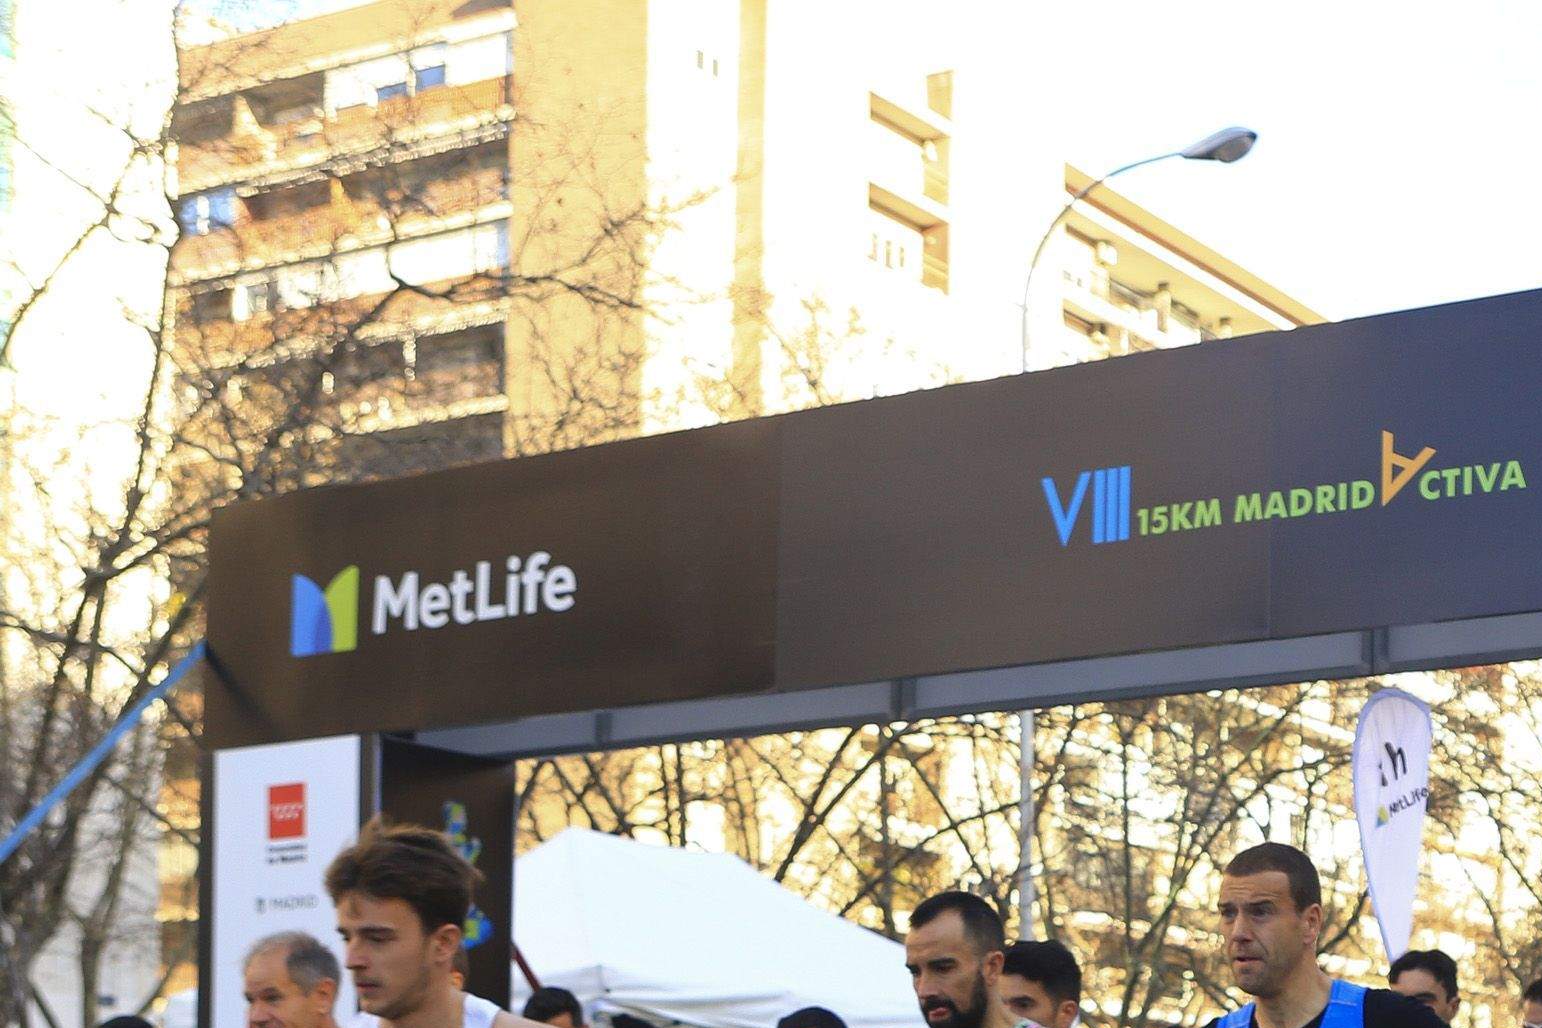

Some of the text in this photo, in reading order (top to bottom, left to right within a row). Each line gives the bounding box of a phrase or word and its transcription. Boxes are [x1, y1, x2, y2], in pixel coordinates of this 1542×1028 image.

[1042, 430, 1527, 547] VIII 15KM MADRID ACTIVA
[372, 551, 578, 635] MetLife
